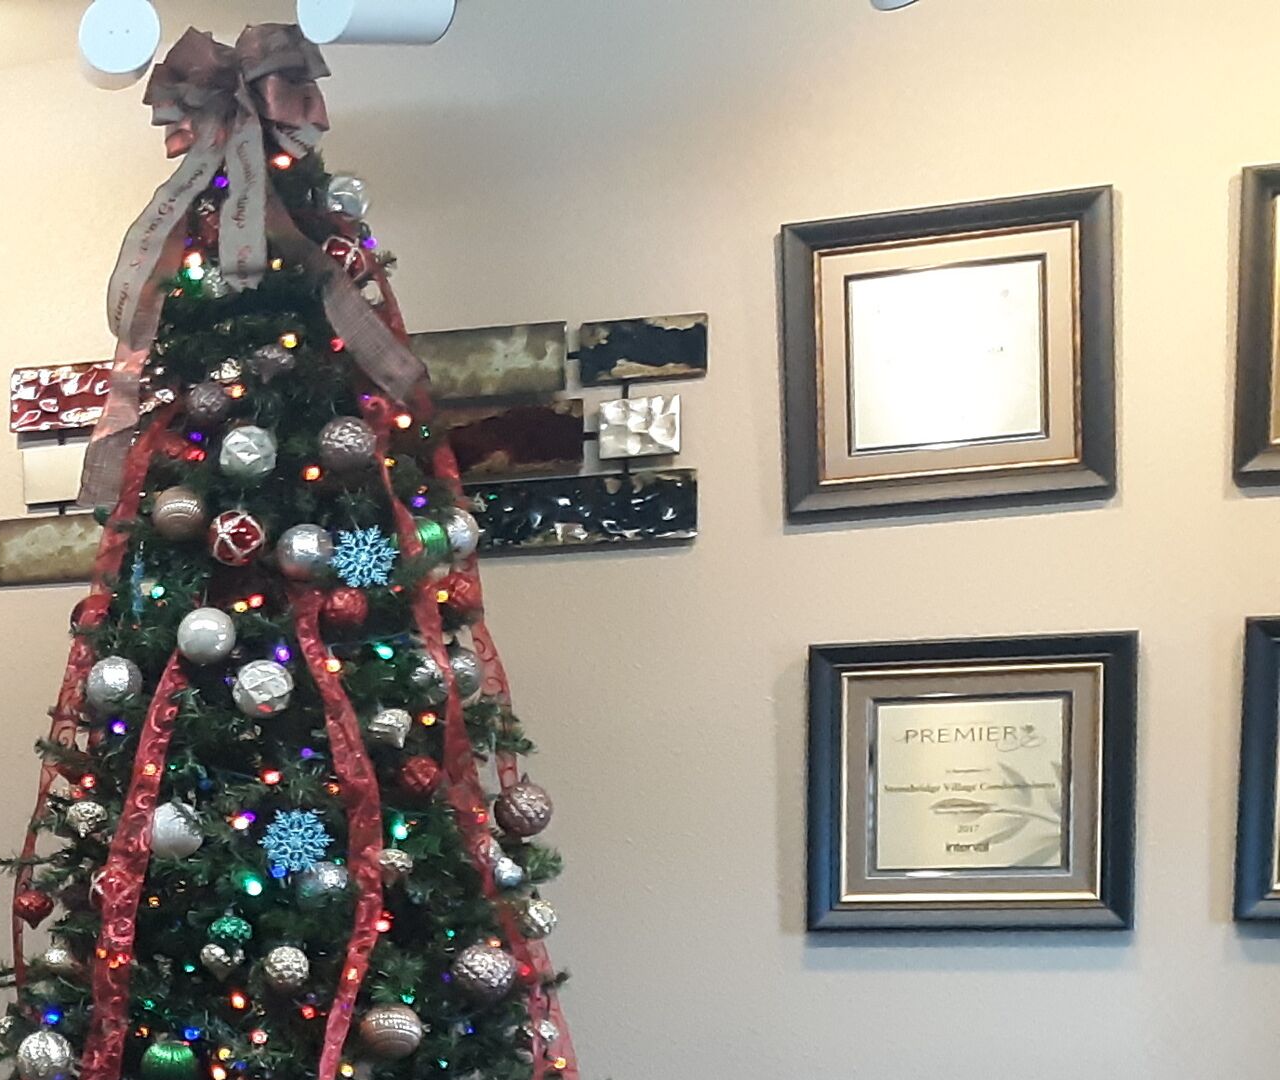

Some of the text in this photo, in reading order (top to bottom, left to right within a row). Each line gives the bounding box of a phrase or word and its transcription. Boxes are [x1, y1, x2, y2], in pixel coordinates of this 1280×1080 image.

[905, 725, 1017, 743] PREMIER
[943, 782, 977, 792] Village
[958, 825, 980, 833] 2017
